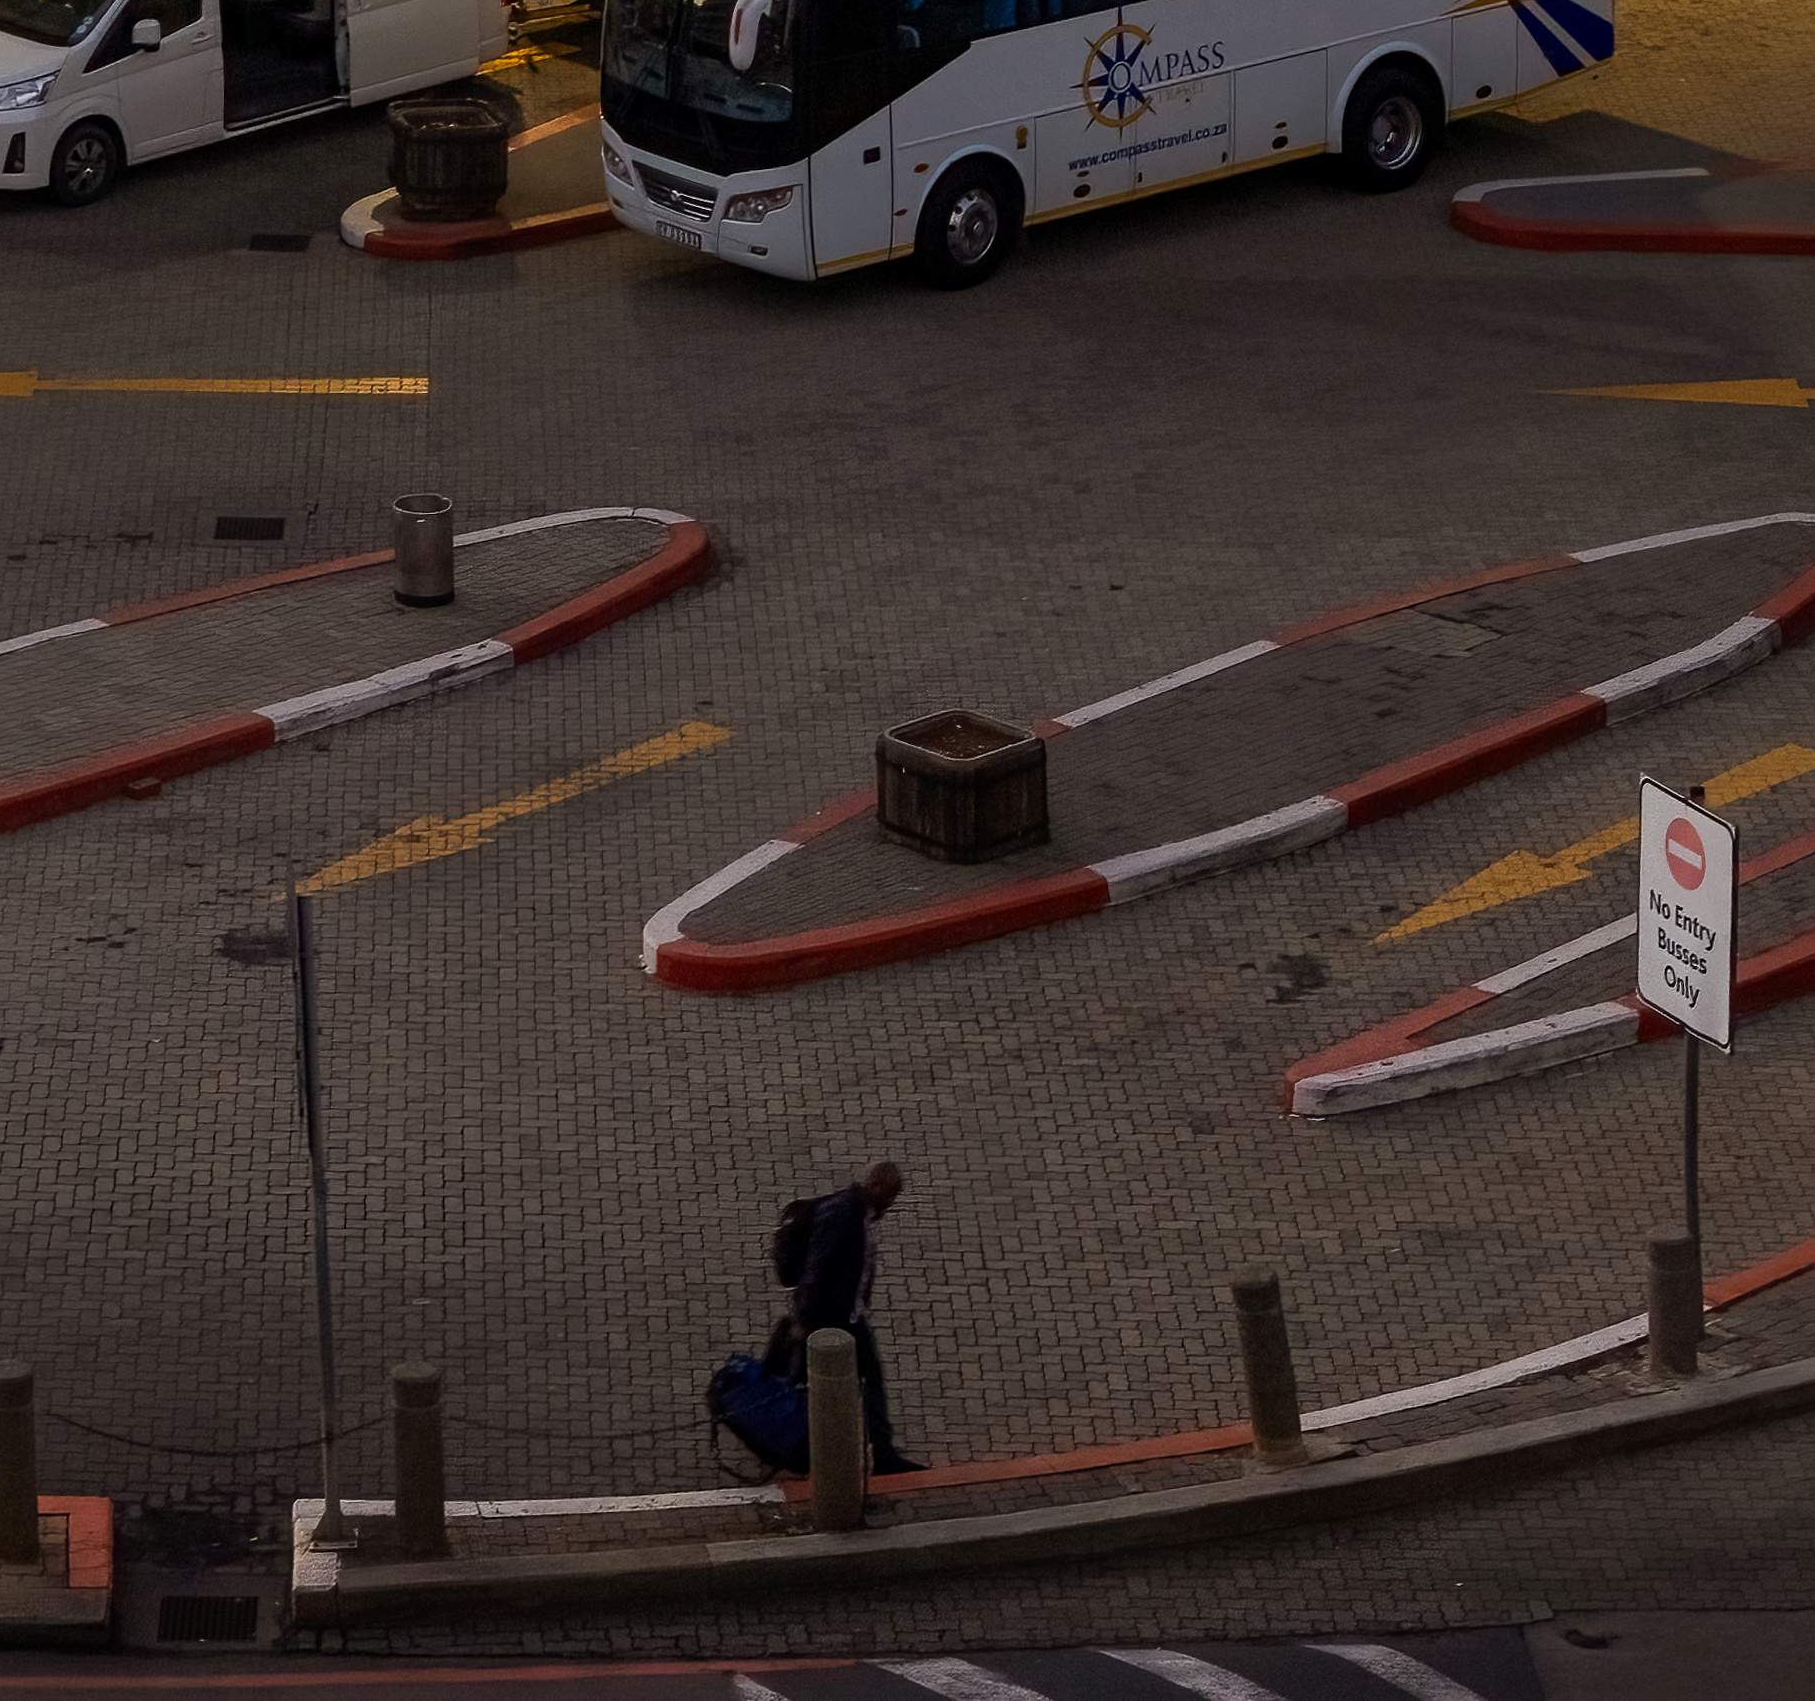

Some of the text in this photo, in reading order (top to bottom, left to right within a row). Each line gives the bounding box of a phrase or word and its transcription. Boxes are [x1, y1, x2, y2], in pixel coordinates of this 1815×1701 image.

[1068, 123, 1228, 171] www.compasstravel.co.za
[1649, 890, 1716, 950] No Entry
[1658, 927, 1707, 974] Busses
[1664, 965, 1700, 1007] Only
